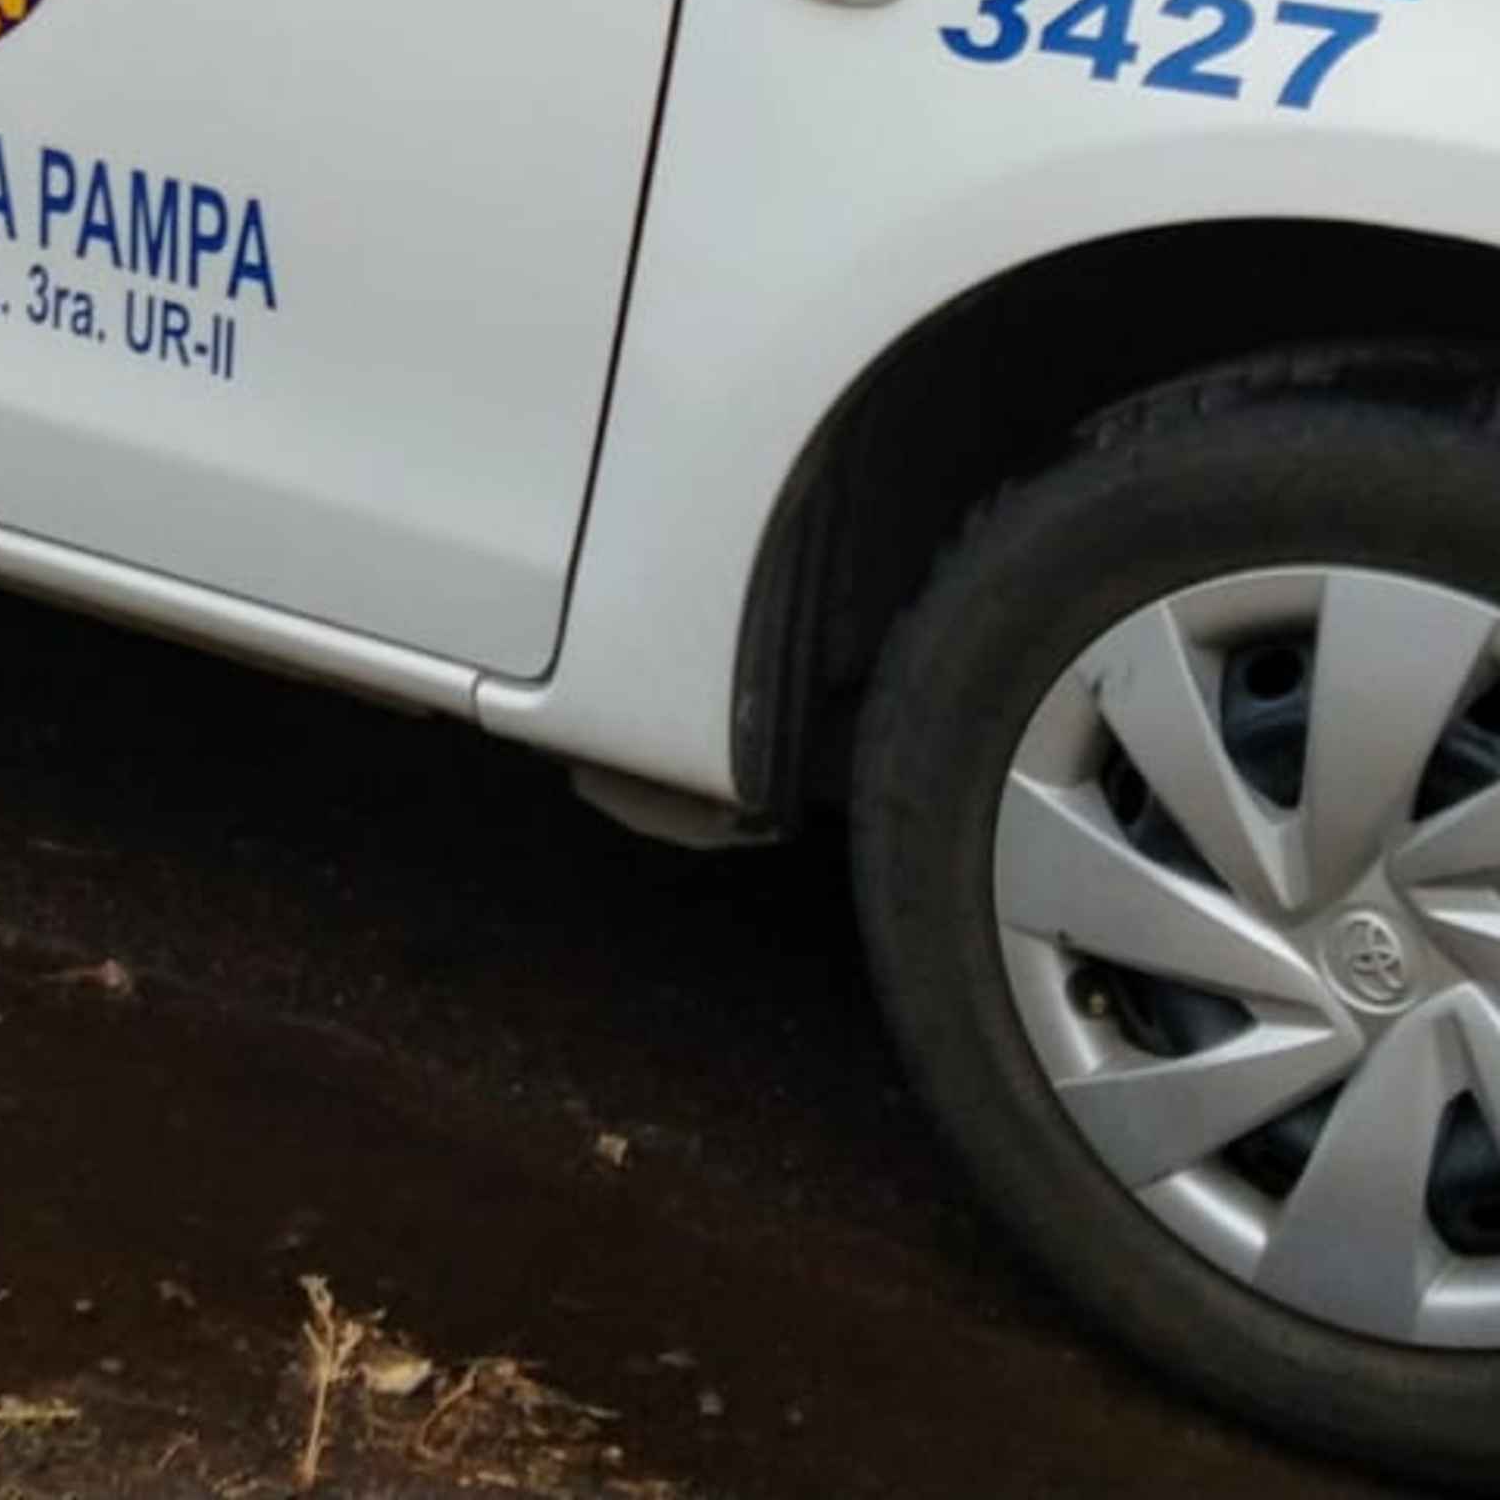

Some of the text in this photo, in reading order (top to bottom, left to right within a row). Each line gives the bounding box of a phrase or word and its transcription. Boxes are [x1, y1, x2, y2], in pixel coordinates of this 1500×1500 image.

[40, 147, 278, 310] PAMPA
[25, 264, 106, 342] 3ra.
[124, 290, 236, 380] UR-II
